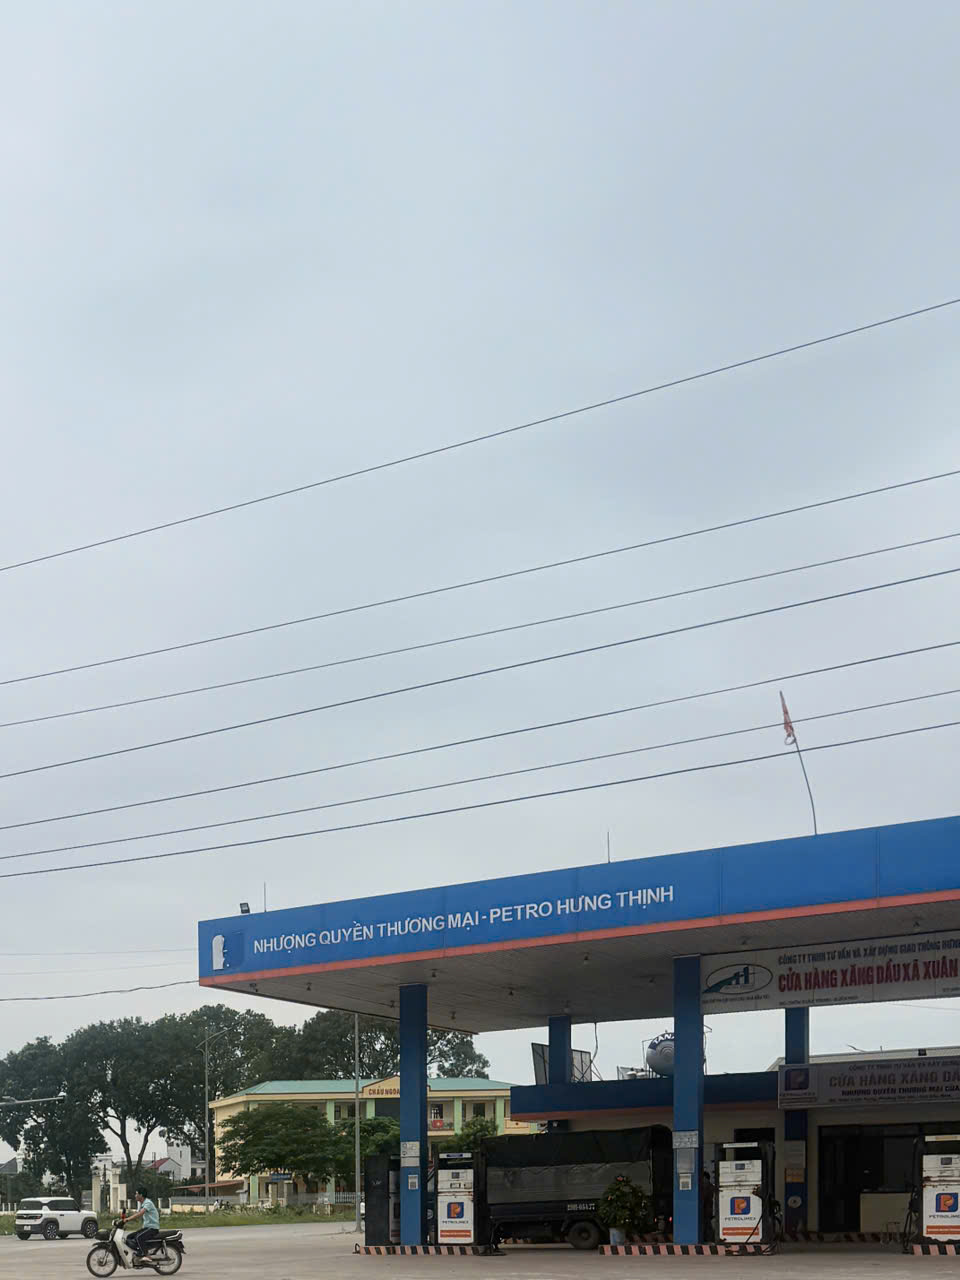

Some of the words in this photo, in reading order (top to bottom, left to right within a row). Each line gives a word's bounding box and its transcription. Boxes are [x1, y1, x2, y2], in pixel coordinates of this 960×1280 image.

[253, 932, 316, 953] NHƯỢNG
[319, 920, 374, 944] QUYỀN
[377, 915, 445, 937] THƯƠNG
[448, 911, 479, 930] MẠI
[489, 901, 553, 923] PETRO
[557, 894, 611, 915] HƯNG
[616, 885, 674, 909] THỊNH
[778, 966, 802, 992] CỬA
[804, 967, 838, 990] HÀNG
[840, 964, 874, 988] XĂNG
[923, 955, 958, 980] XUÂN
